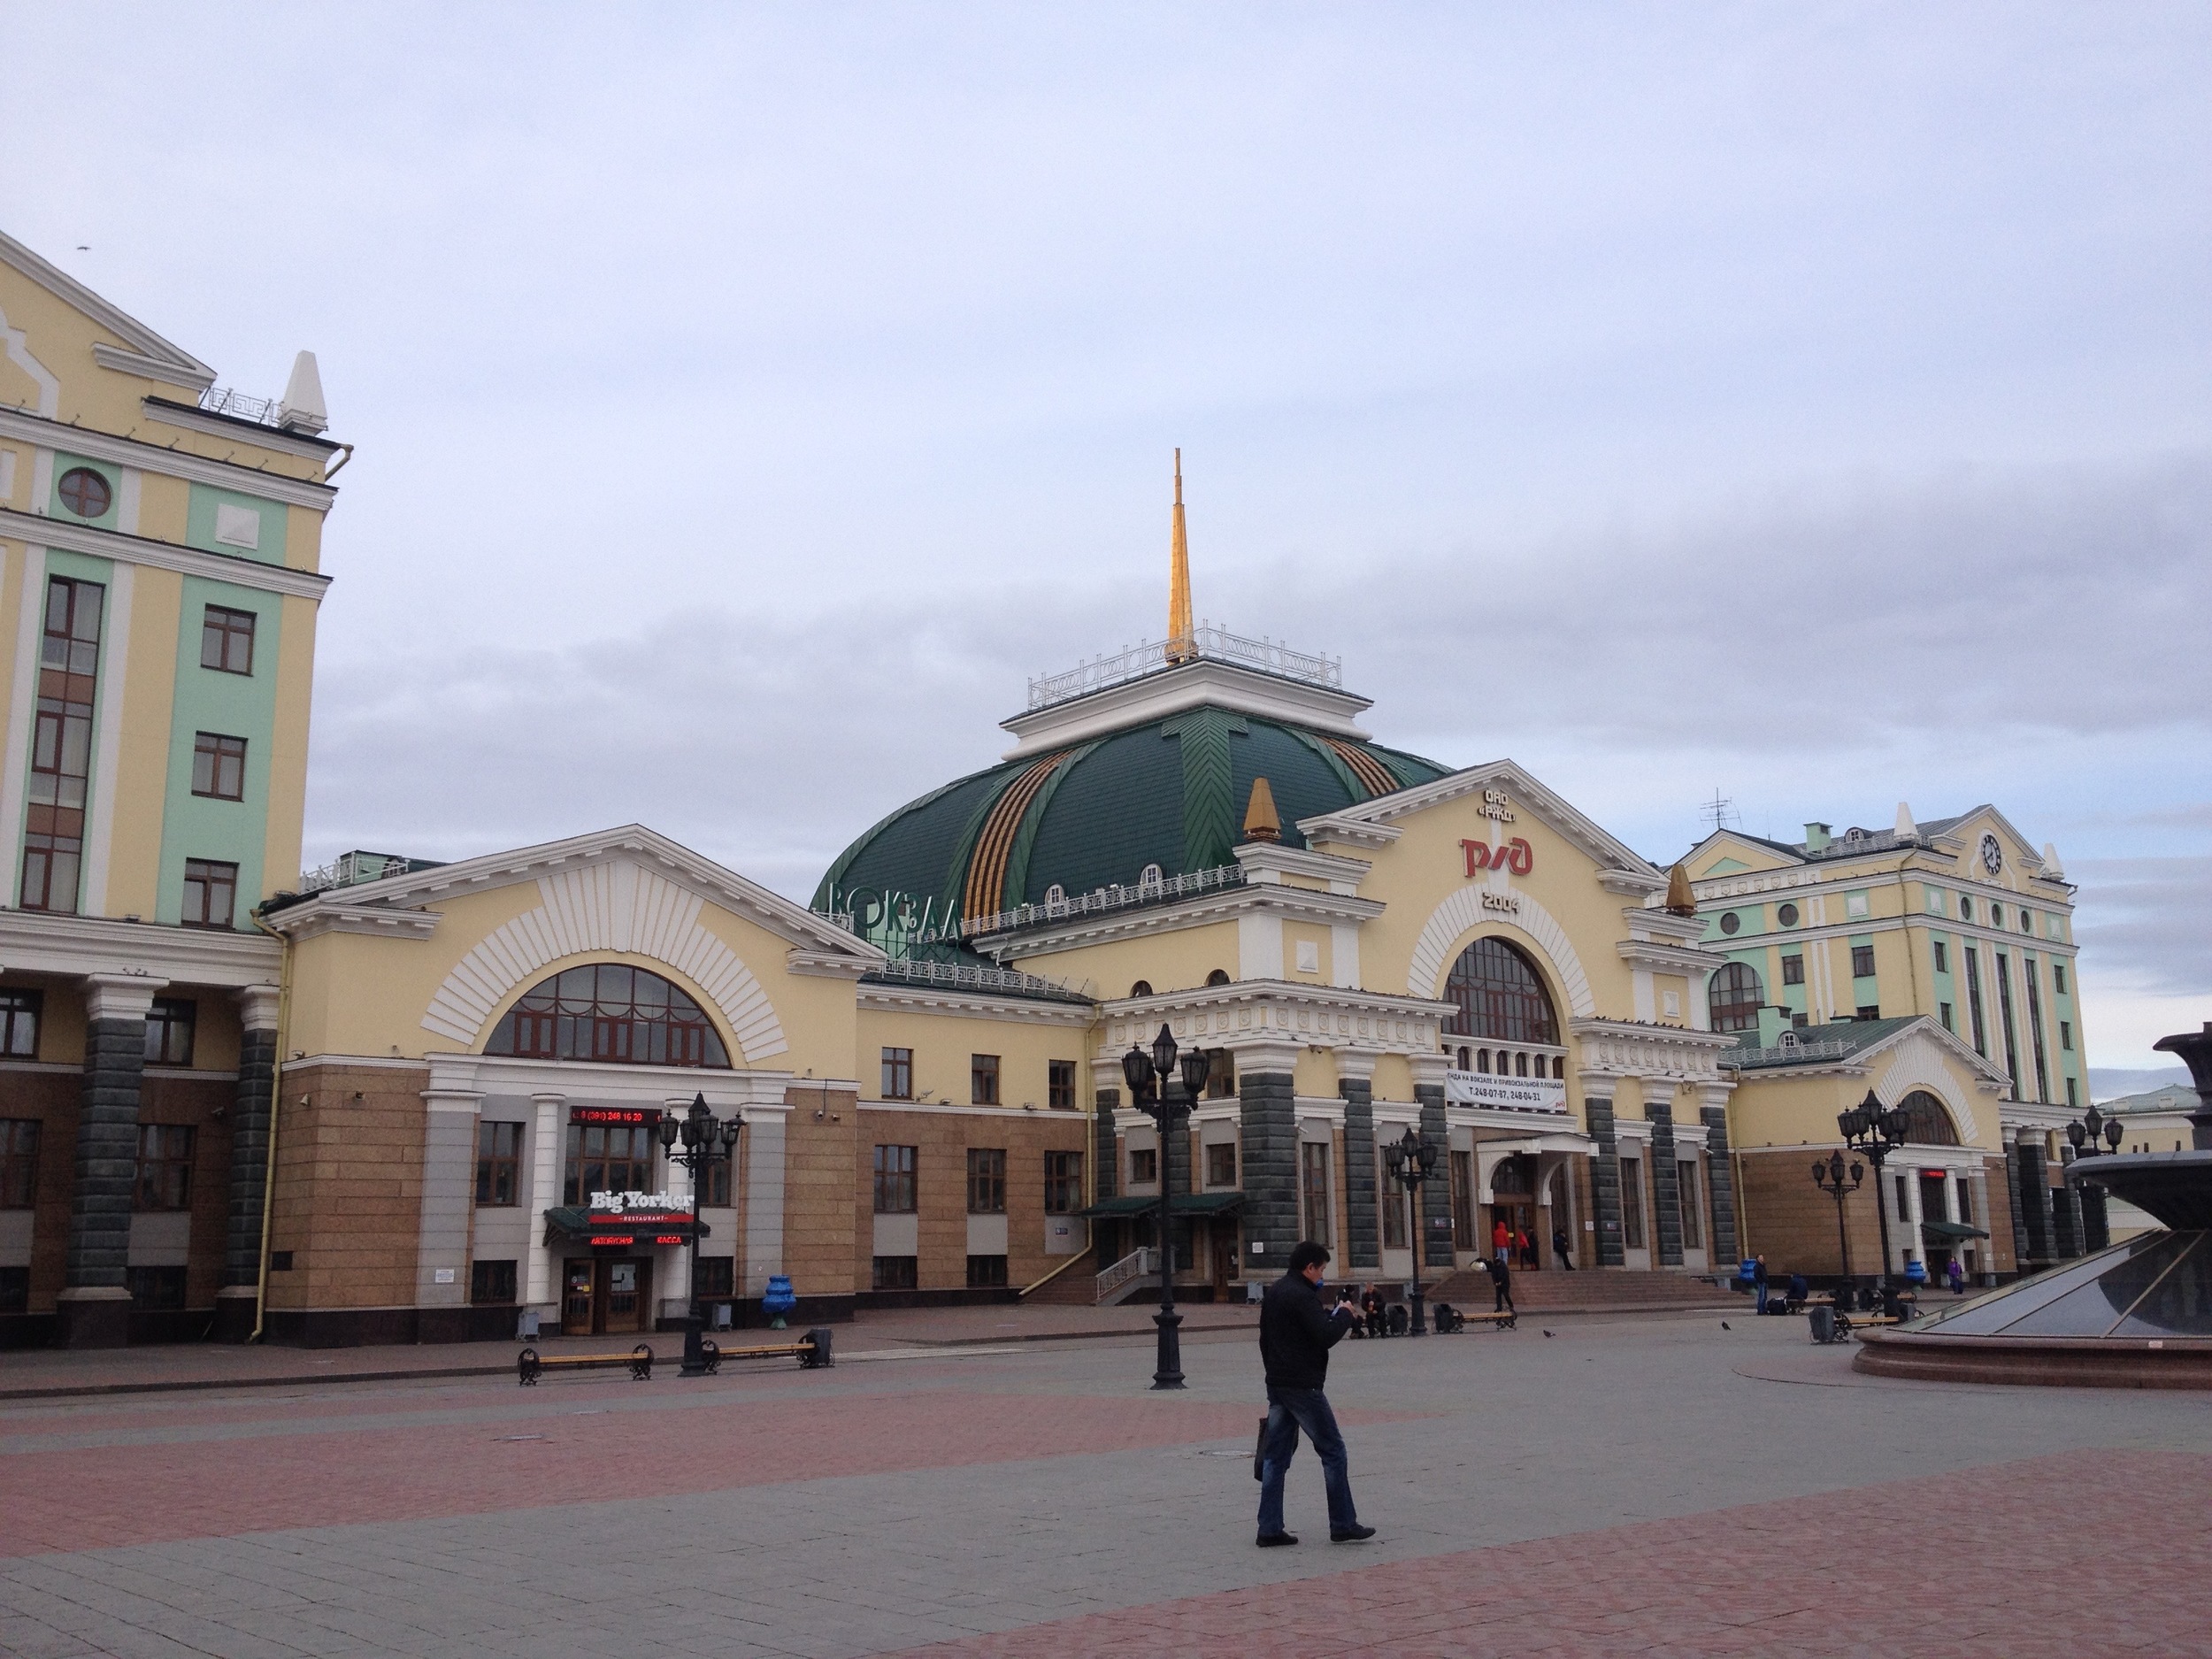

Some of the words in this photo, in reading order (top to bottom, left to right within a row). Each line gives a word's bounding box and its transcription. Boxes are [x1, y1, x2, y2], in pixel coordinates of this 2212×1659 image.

[1484, 789, 1509, 805] ОАО
[829, 882, 964, 941] ВОКЗАЛ
[1482, 892, 1521, 913] 2004
[1510, 1090, 1541, 1101] 248-04-31
[590, 1190, 624, 1214] Big
[624, 1190, 695, 1213] Yorker
